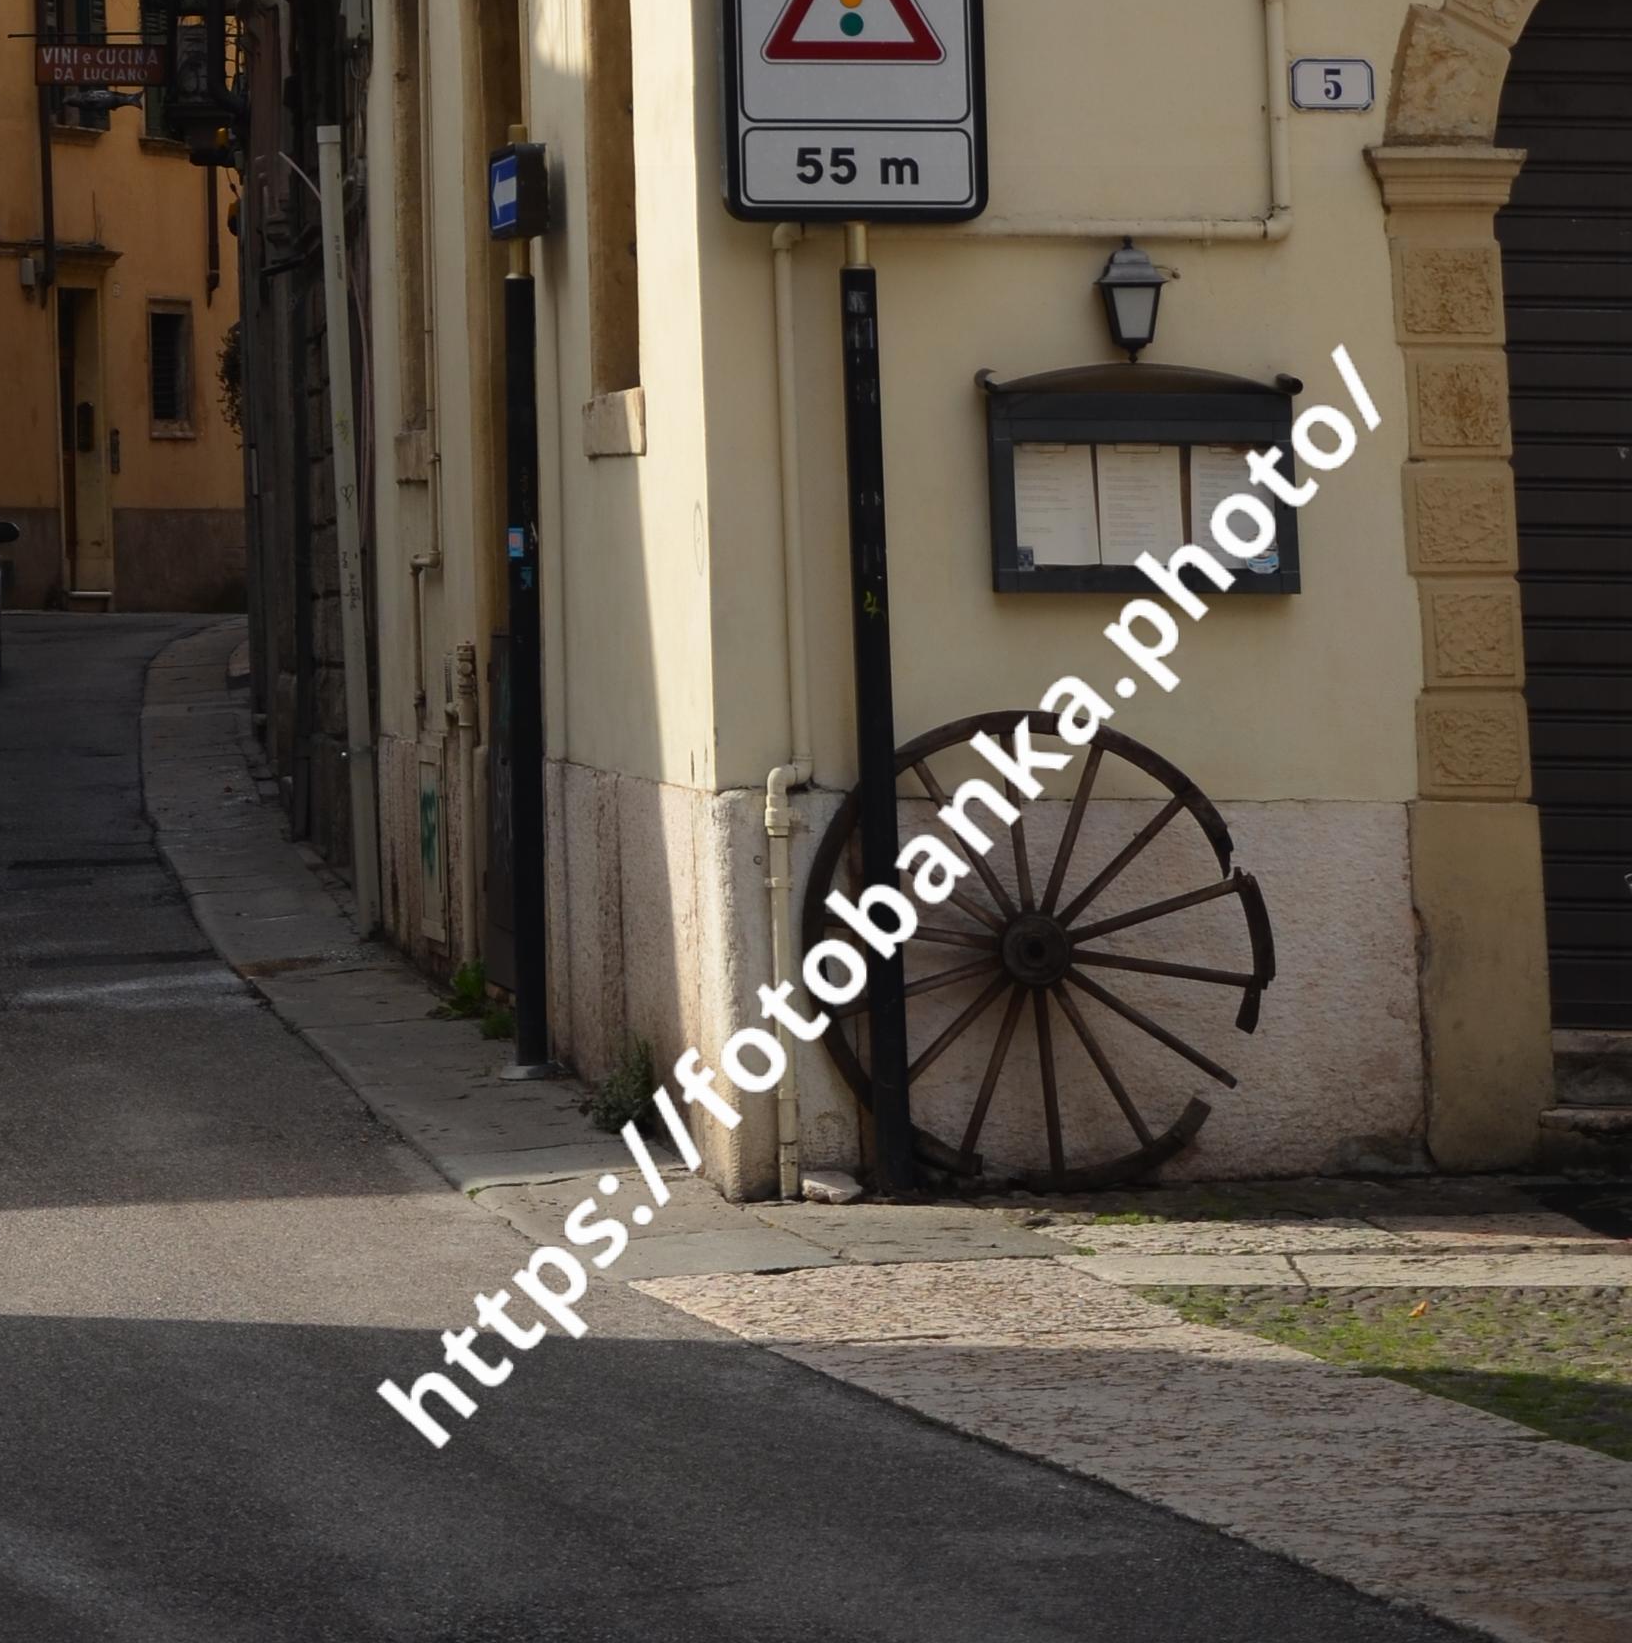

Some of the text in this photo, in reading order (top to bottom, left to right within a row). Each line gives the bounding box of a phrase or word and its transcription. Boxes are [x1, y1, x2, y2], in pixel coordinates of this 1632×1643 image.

[41, 48, 159, 65] VINI e CUCINA
[54, 68, 148, 81] DA LUCIANO
[1324, 68, 1342, 100] 5
[796, 147, 919, 185] 55 m
